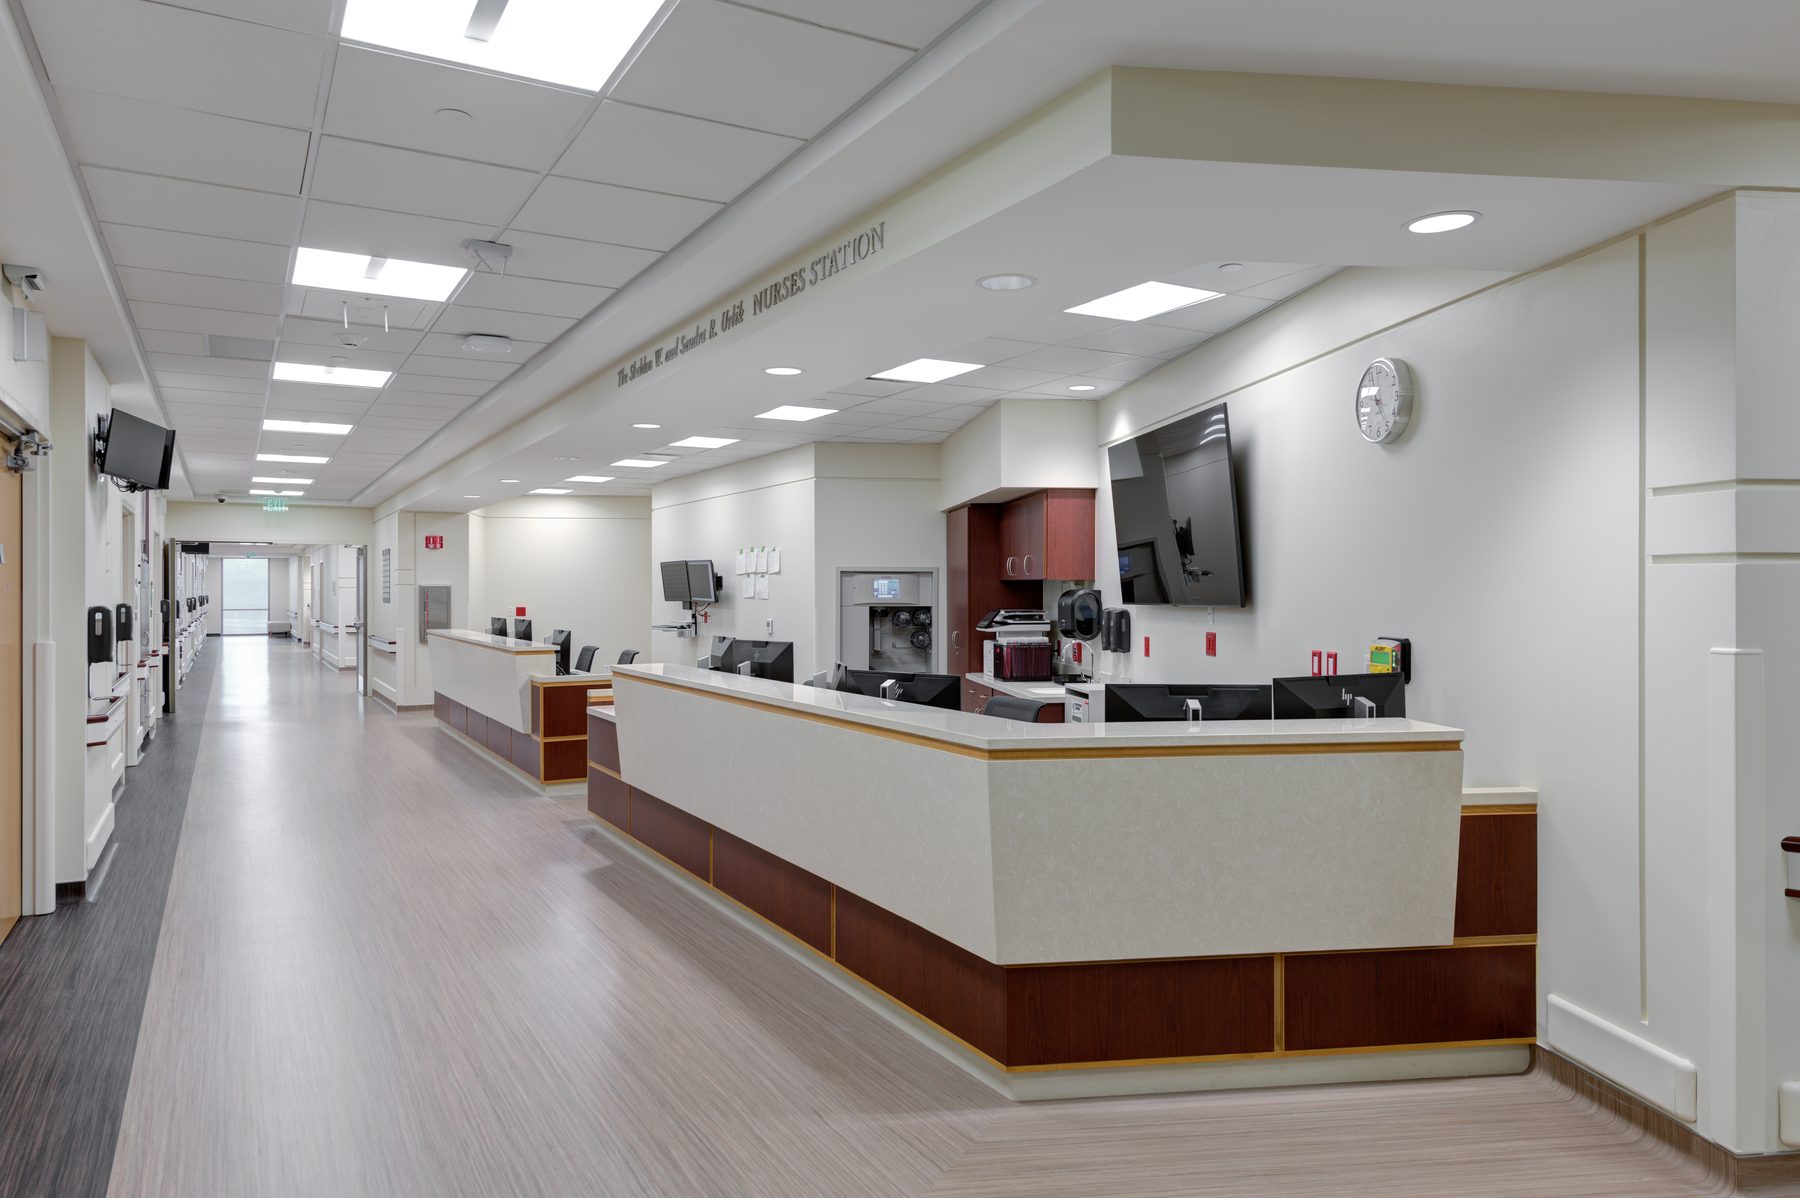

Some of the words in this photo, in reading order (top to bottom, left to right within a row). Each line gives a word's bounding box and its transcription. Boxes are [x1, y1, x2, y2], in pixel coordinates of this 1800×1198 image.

[665, 336, 679, 362] and
[709, 318, 718, 340] R.
[752, 267, 806, 316] NURSES
[809, 221, 886, 286] STATION
[1342, 687, 1353, 706] hp
